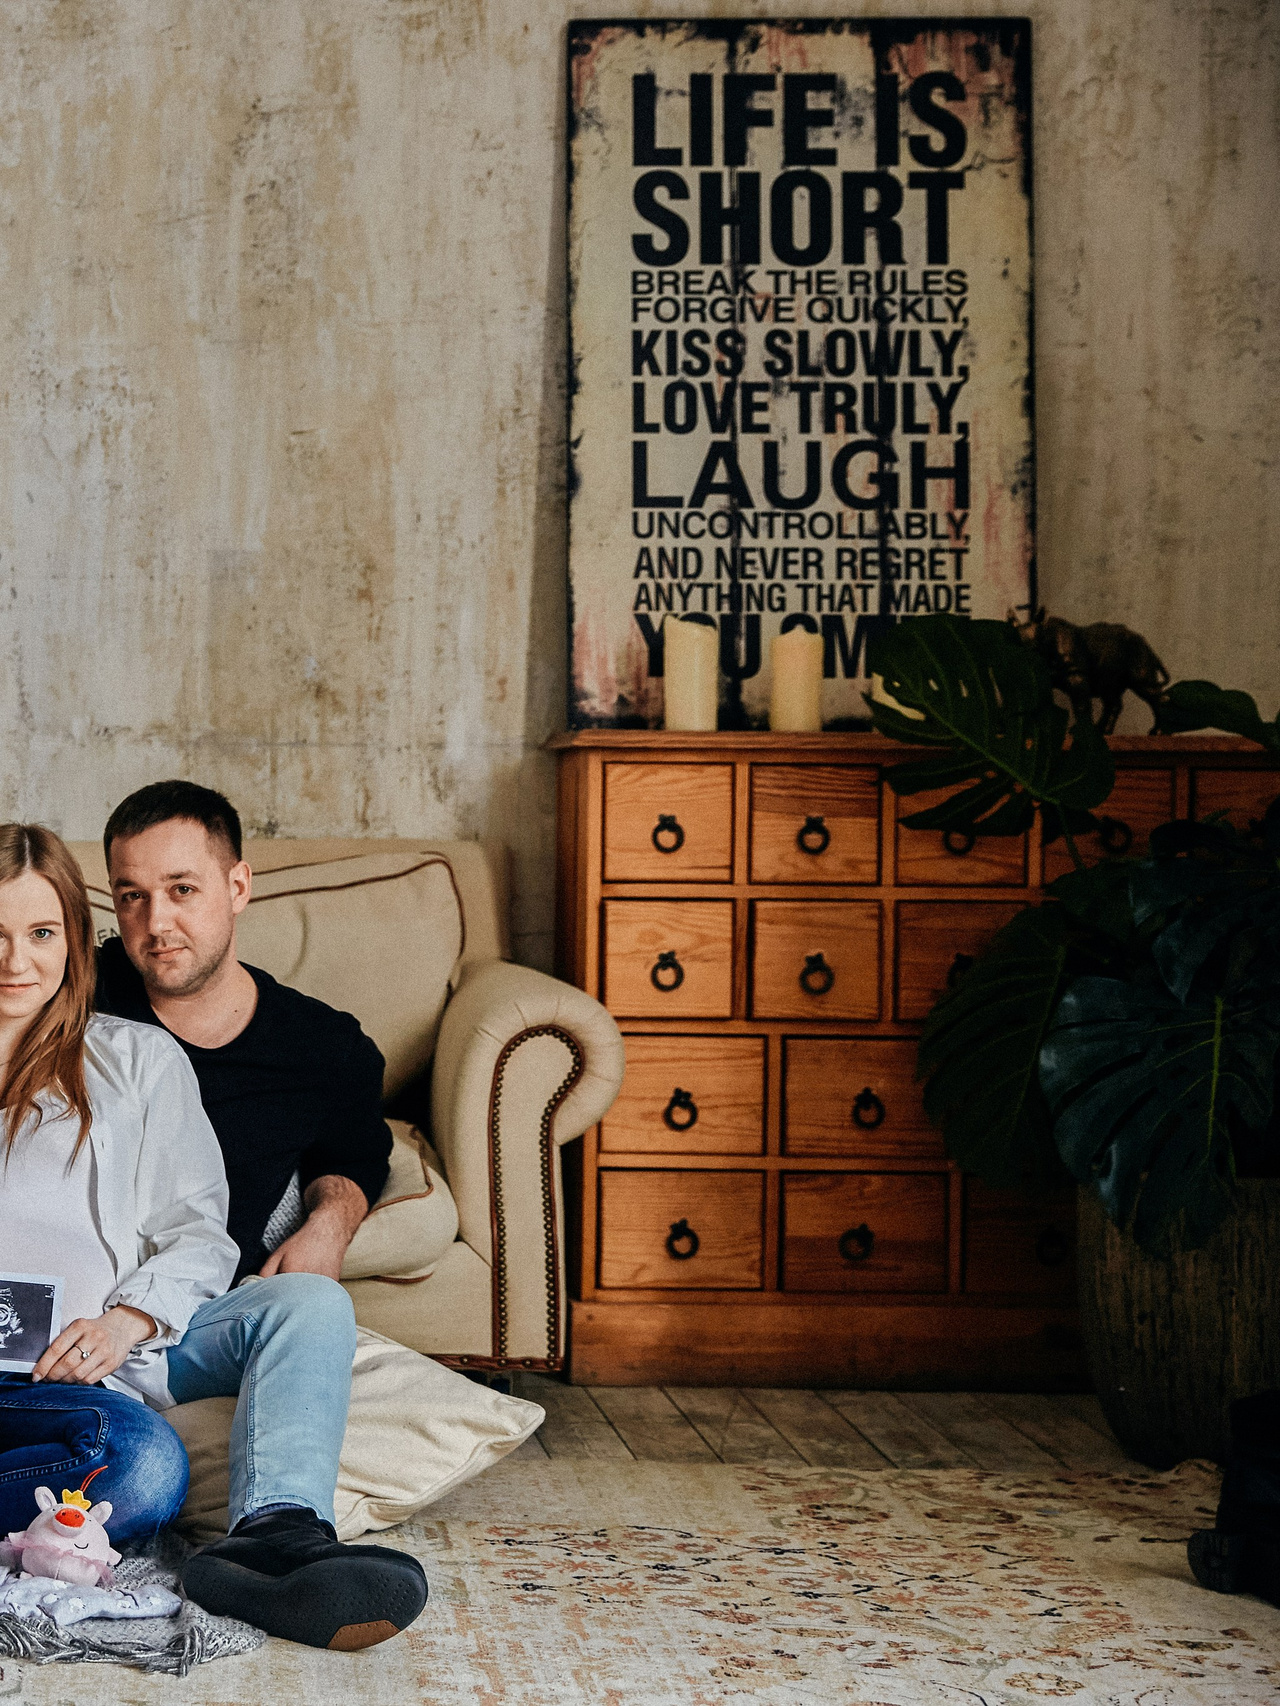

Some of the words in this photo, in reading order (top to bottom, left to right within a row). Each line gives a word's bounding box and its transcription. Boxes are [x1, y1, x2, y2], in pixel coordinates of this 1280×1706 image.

[632, 72, 838, 167] LIFE
[876, 71, 969, 169] IS
[631, 169, 967, 267] SHORT
[631, 270, 758, 296] BREAK
[766, 270, 837, 296] THE
[848, 270, 969, 296] RULES
[631, 297, 796, 325] FORGIVE
[806, 297, 970, 328] QUICKLY,
[631, 329, 745, 378] KISS
[764, 329, 970, 382] SLOWLY,
[631, 382, 771, 435] LOVE
[788, 382, 970, 440] TRULY,
[631, 440, 971, 510] LAUGH
[632, 511, 971, 544] UNCONTROLLABLY,
[633, 547, 703, 580] AND
[715, 547, 823, 580] NEVER
[835, 547, 970, 580] REGRET
[633, 583, 787, 614] ANYTHING
[796, 583, 875, 613] THAT
[890, 584, 971, 614] MADE
[634, 613, 763, 679] YU
